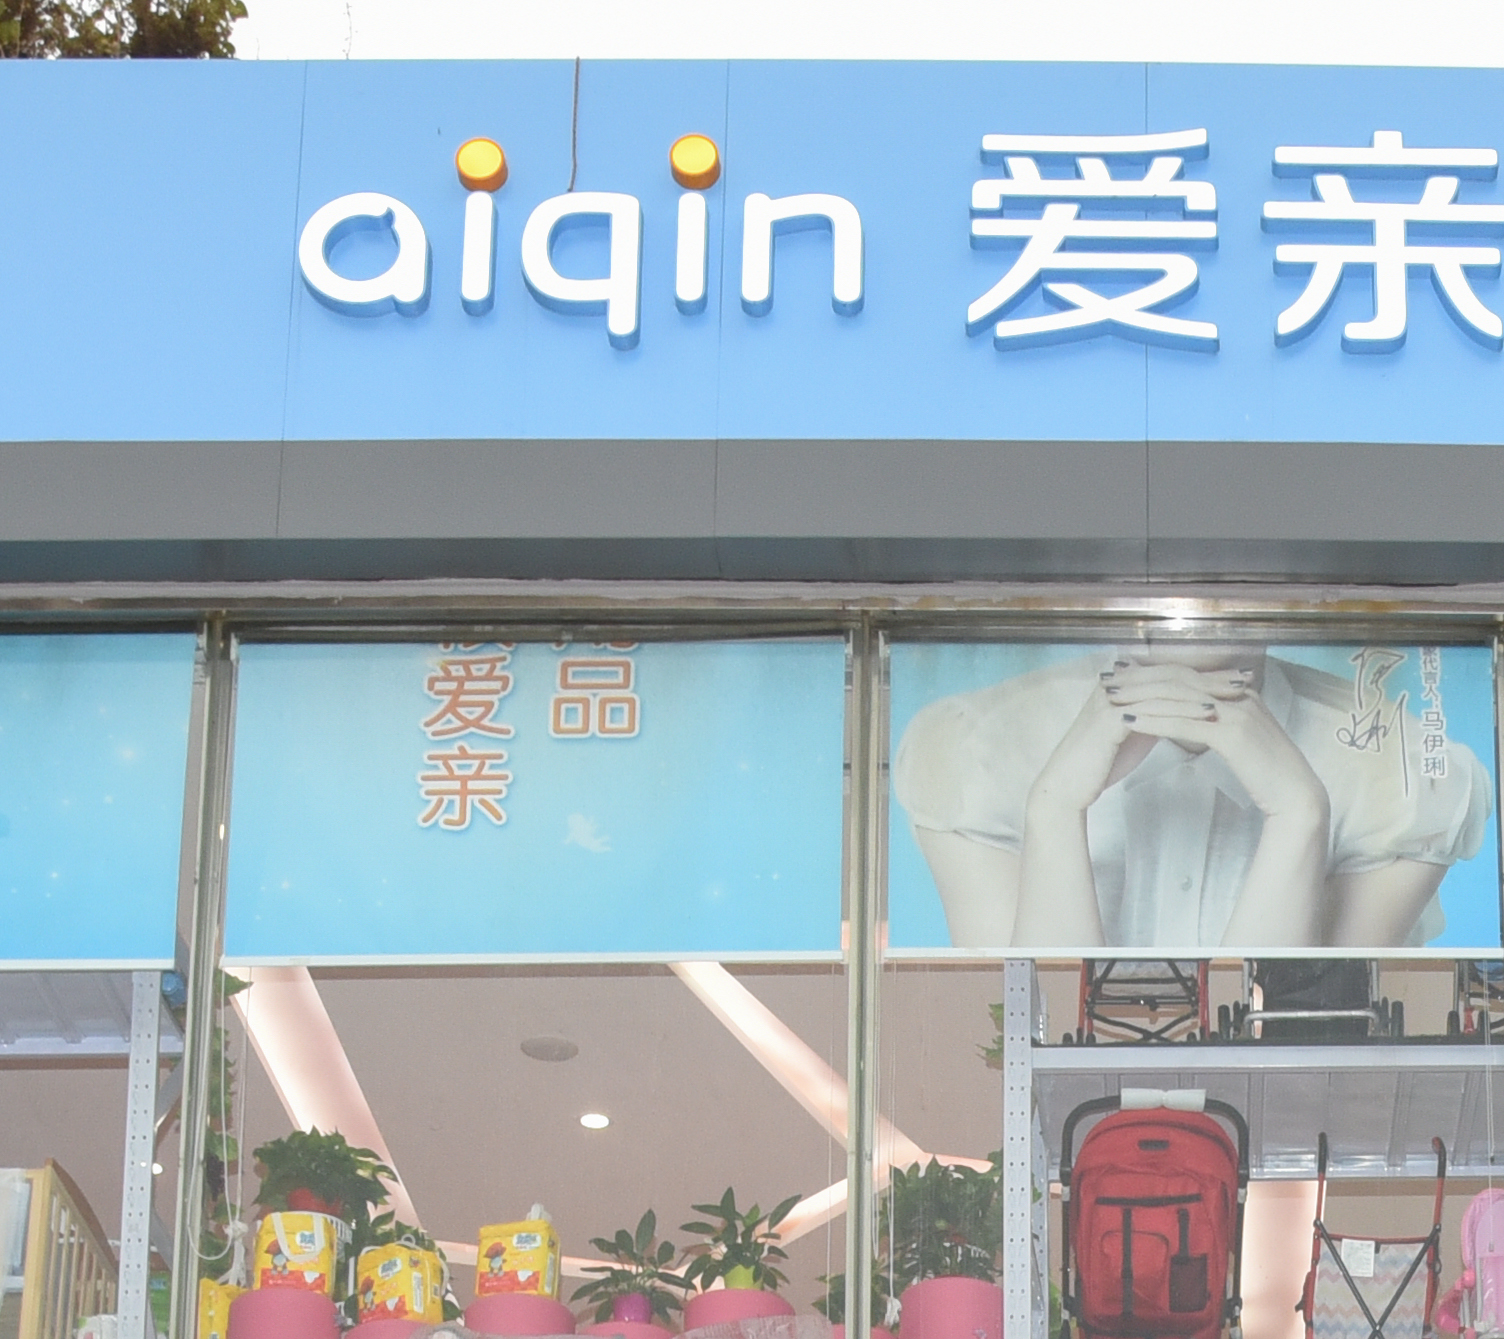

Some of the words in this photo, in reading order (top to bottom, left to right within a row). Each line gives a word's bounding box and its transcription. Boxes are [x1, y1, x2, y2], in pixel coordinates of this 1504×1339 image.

[300, 134, 862, 350] aiqin
[417, 641, 515, 830] 爱亲
[550, 641, 640, 738] 品
